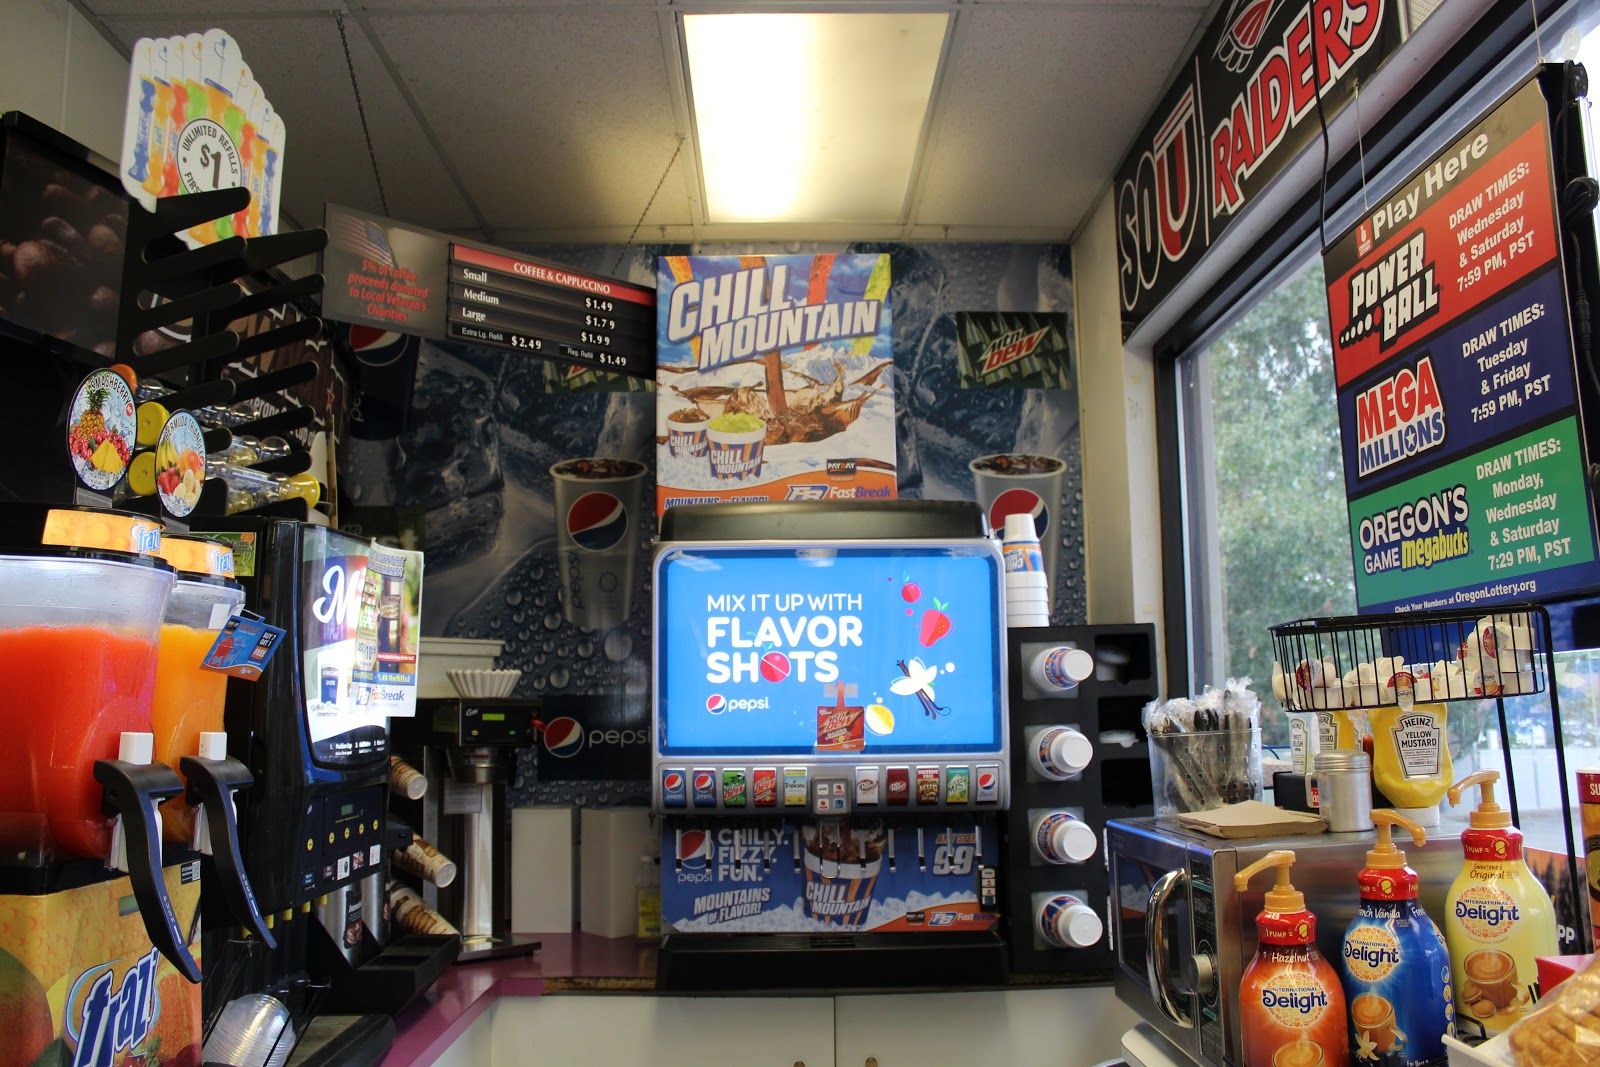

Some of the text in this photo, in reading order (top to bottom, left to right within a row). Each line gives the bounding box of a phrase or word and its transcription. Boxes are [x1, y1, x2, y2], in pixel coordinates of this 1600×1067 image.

[1210, 0, 1384, 219] RAIDERS
[182, 125, 217, 152] UNLIMITED
[218, 134, 239, 175] REFILLS
[200, 143, 222, 190] $1
[184, 171, 204, 194] FIRS
[1372, 133, 1489, 241] Play Here
[1448, 161, 1530, 230] DRAW TIMES:
[1457, 191, 1525, 247] Wednesday
[1459, 216, 1525, 269] & Saturday
[360, 259, 417, 283] 5% of coffee
[1351, 231, 1425, 319] POWER
[1456, 230, 1536, 293] 7:59 PM, PST
[347, 271, 428, 299] proceeds donated
[463, 268, 613, 312] Small $1.49
[513, 262, 611, 295] COFFEE & CAPPUCCINO
[349, 287, 427, 312] to Local Veteran's
[367, 304, 408, 322] Charities
[463, 288, 615, 330] Medium $1.79
[668, 264, 792, 342] CHILL
[1383, 267, 1438, 343] BALL
[461, 326, 476, 337] Extra
[477, 329, 487, 340] Lg.
[511, 335, 542, 351] $2.49
[462, 307, 610, 346] Large $1.99
[699, 300, 880, 373] MOUNTAIN
[1462, 303, 1545, 359] DRAW TIMES:
[599, 353, 627, 367] $1.49
[1477, 338, 1529, 373] Tuesday
[90, 374, 131, 406] SMASHBERRY
[1481, 360, 1531, 396] & Friday
[1357, 358, 1440, 445] MEGA
[1470, 374, 1551, 424] 7:59 PM, PST
[165, 415, 204, 456] BERMUDA TRIANGLE
[670, 435, 694, 447] CHILL
[1359, 410, 1445, 474] MILLIONS
[711, 449, 743, 465] CHILL
[717, 456, 762, 474] MOUNTAIN
[827, 462, 855, 470] PAYDAY
[1475, 437, 1562, 481] DRAW TIMES:
[829, 485, 892, 500] FastBreak
[1492, 472, 1544, 499] Monday,
[1359, 486, 1469, 550] OREGON'S
[1485, 493, 1557, 524] Wednesday
[1490, 518, 1560, 547] & Saturday
[1364, 527, 1469, 574] GAME megabucks
[1487, 537, 1572, 571] 7:29 PM, PST
[707, 593, 863, 613] MIX IT UP WITH
[1394, 579, 1537, 614] Check Your Numbers at OregonLottery.org
[259, 638, 268, 646] GET
[263, 631, 272, 640] BUY
[706, 615, 863, 649] FLAVOR
[253, 648, 267, 658] FREE
[706, 650, 839, 684] SHOTS
[728, 696, 769, 712] pepsi
[1404, 715, 1432, 728] HEINZ
[1405, 731, 1432, 739] YELLOW
[589, 728, 652, 748] pepsi
[1401, 738, 1437, 748] MUSTARD
[932, 845, 975, 876] 99
[1468, 846, 1483, 854] PUMP
[677, 872, 713, 884] pepsi
[718, 864, 763, 882] FUN.
[1469, 869, 1505, 882] Original
[1473, 863, 1502, 871] Sweetened
[694, 888, 772, 915] MOUNTAINS
[806, 881, 846, 903] CHILL
[812, 896, 872, 915] MOUNTAIN
[708, 903, 762, 924] OF FLAVOR!
[1374, 904, 1401, 919] Vanilla
[1456, 901, 1520, 926] Delight
[1269, 930, 1287, 938] PUMP
[1271, 950, 1310, 963] Hazelnut
[1344, 941, 1400, 968] Delight
[1262, 988, 1328, 1014] Delight
